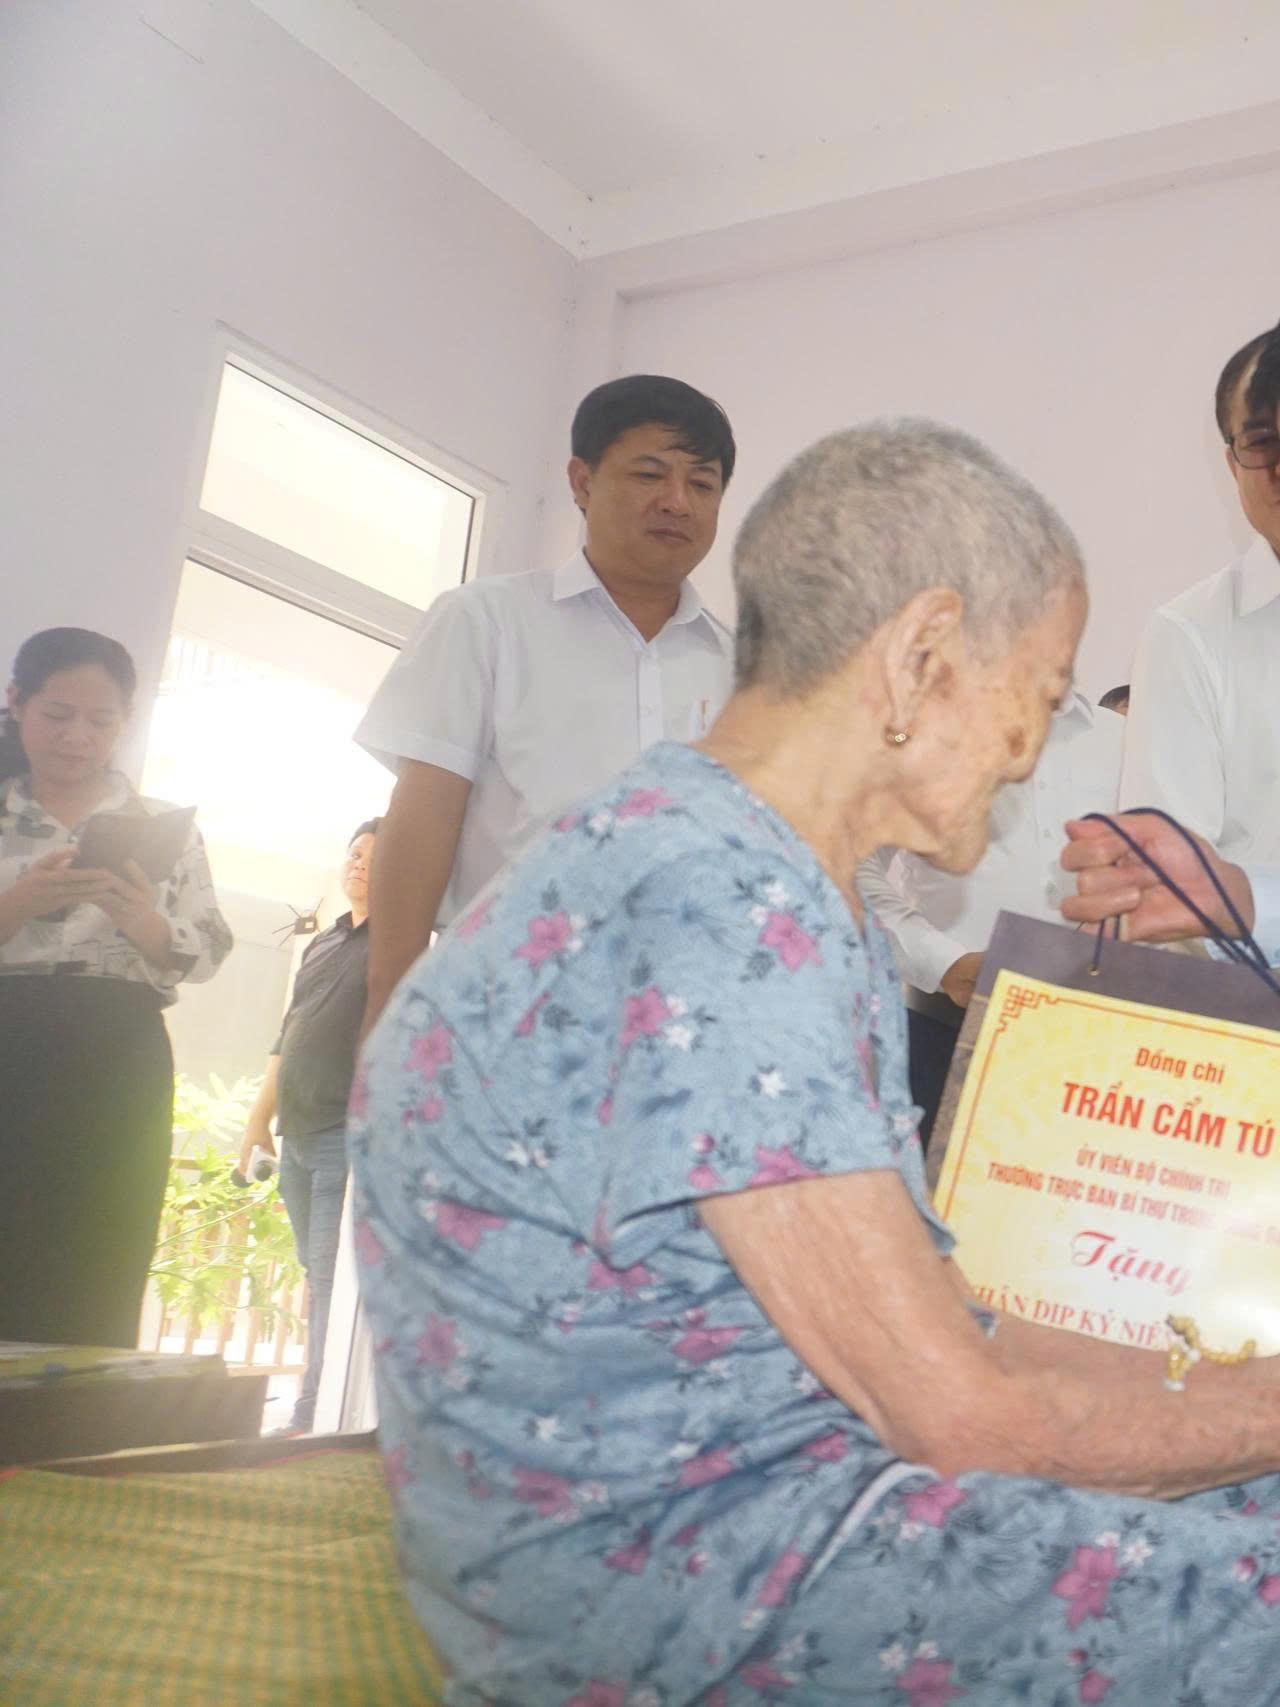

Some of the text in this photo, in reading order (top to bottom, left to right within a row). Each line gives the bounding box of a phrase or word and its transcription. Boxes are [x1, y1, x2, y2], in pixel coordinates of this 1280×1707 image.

[1236, 1119, 1276, 1158] TÚ
[1086, 1184, 1118, 1208] BAN
[1071, 1231, 1192, 1296] Tặng
